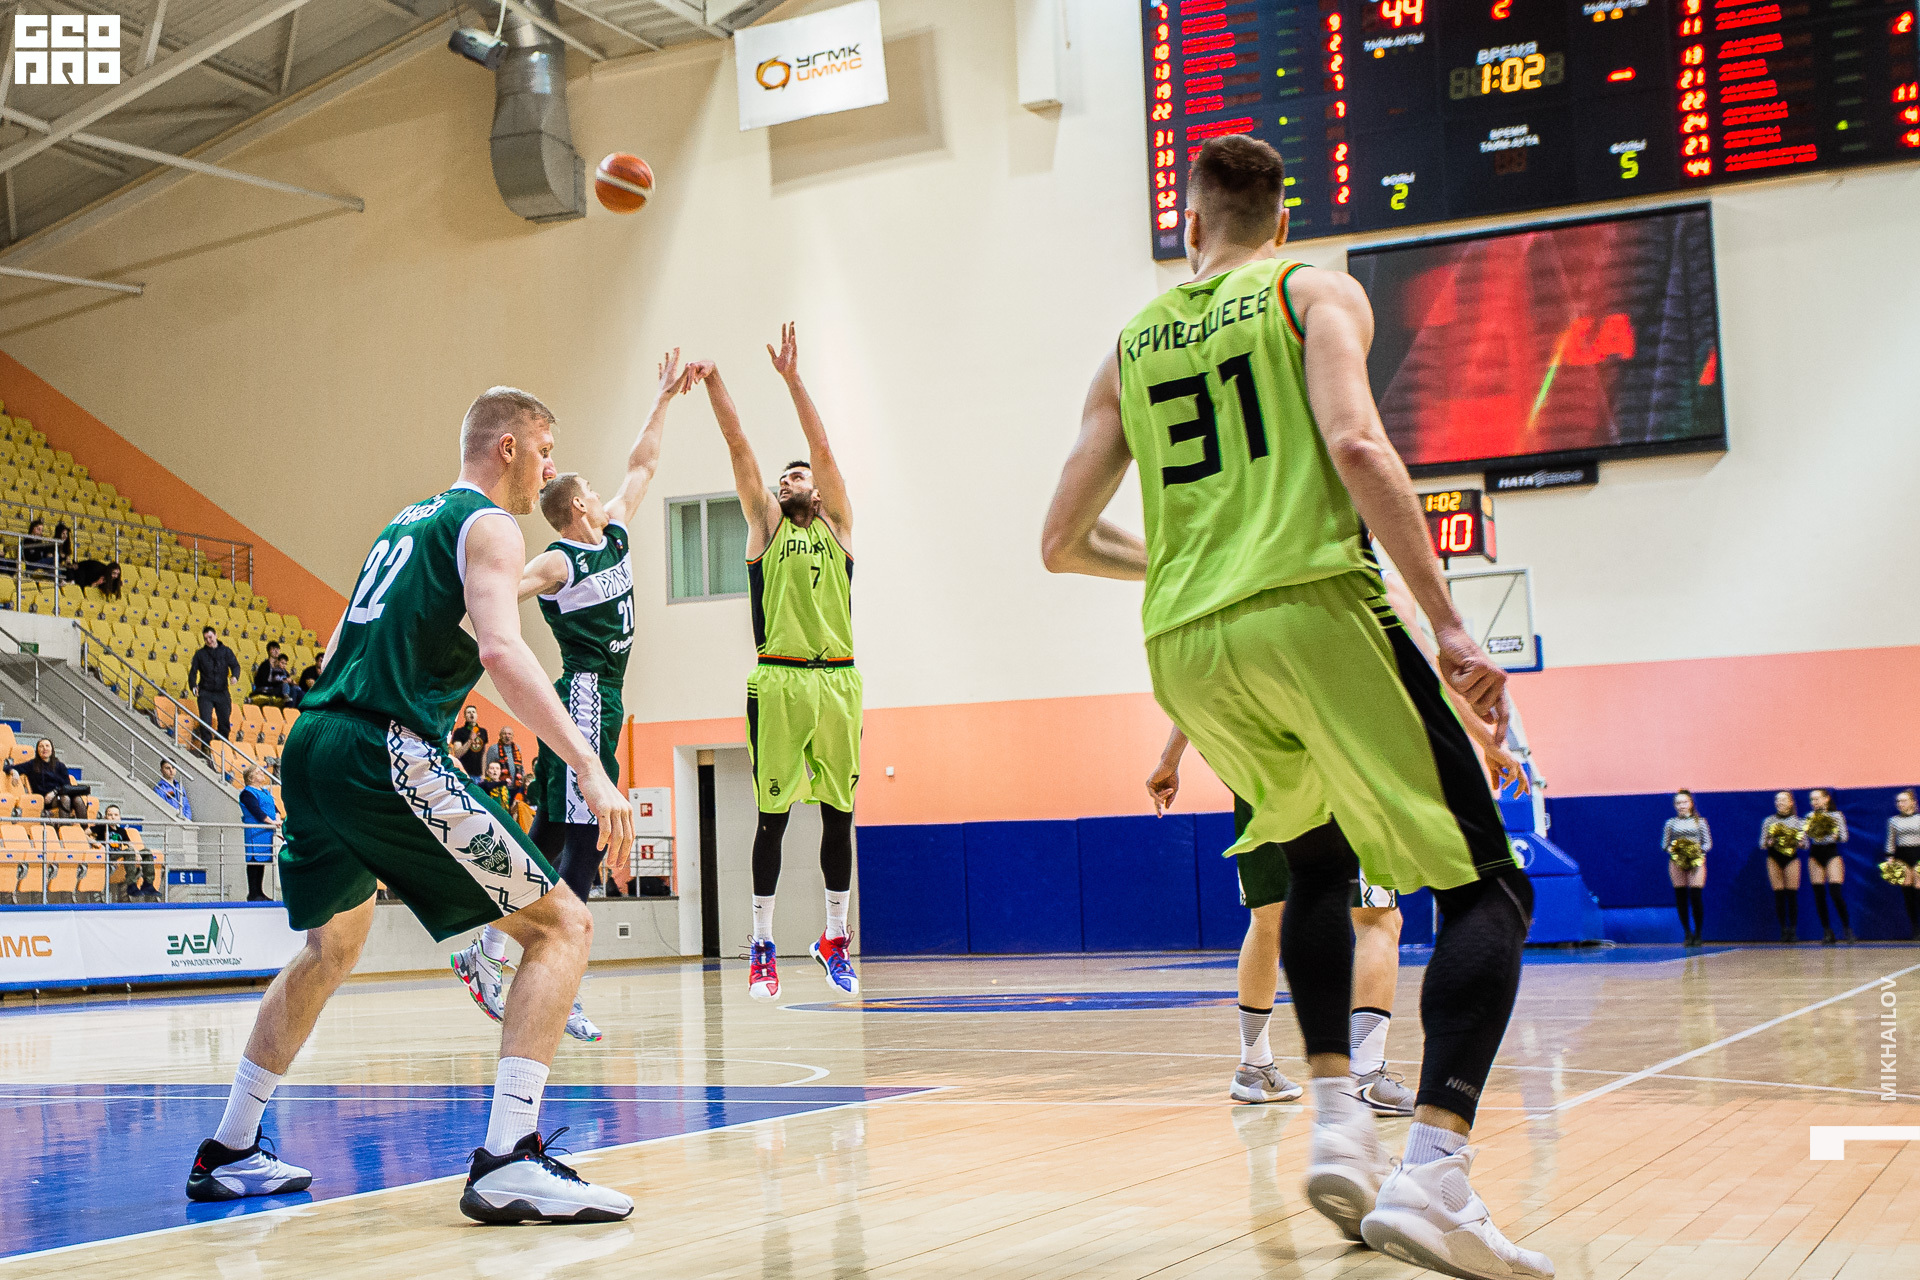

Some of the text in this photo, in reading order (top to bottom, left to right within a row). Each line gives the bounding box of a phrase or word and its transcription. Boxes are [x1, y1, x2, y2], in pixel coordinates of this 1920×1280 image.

[1380, 0, 1424, 28] 44
[1892, 11, 1914, 34] 2
[1680, 16, 1702, 36] 11
[1327, 32, 1343, 53] 2
[1476, 40, 1538, 65] ВРЕМЯ
[796, 44, 860, 68] УГМК
[1328, 52, 1344, 73] 2
[796, 57, 862, 81] UMMC
[1481, 52, 1546, 94] 1:02
[1678, 67, 1706, 90] 21
[1679, 89, 1707, 111] 22
[1892, 82, 1918, 102] 11
[1151, 101, 1173, 122] 22
[1154, 128, 1174, 148] 31
[1683, 133, 1711, 156] 27
[1155, 147, 1175, 168] 33
[1333, 142, 1348, 162] 2
[1620, 150, 1639, 179] 5
[1684, 157, 1712, 178] 44
[1155, 169, 1176, 189] 51
[1335, 184, 1350, 205] 2
[1391, 183, 1409, 210] 2
[1147, 351, 1269, 489] 31
[1425, 491, 1462, 513] 1:02
[1440, 513, 1473, 552] 10
[346, 535, 414, 624] 22
[810, 565, 821, 589] 7
[617, 594, 634, 635] 21
[850, 774, 860, 791] 7
[179, 871, 186, 883] E
[0, 935, 52, 957] MC
[1445, 1077, 1477, 1099] NIKE
